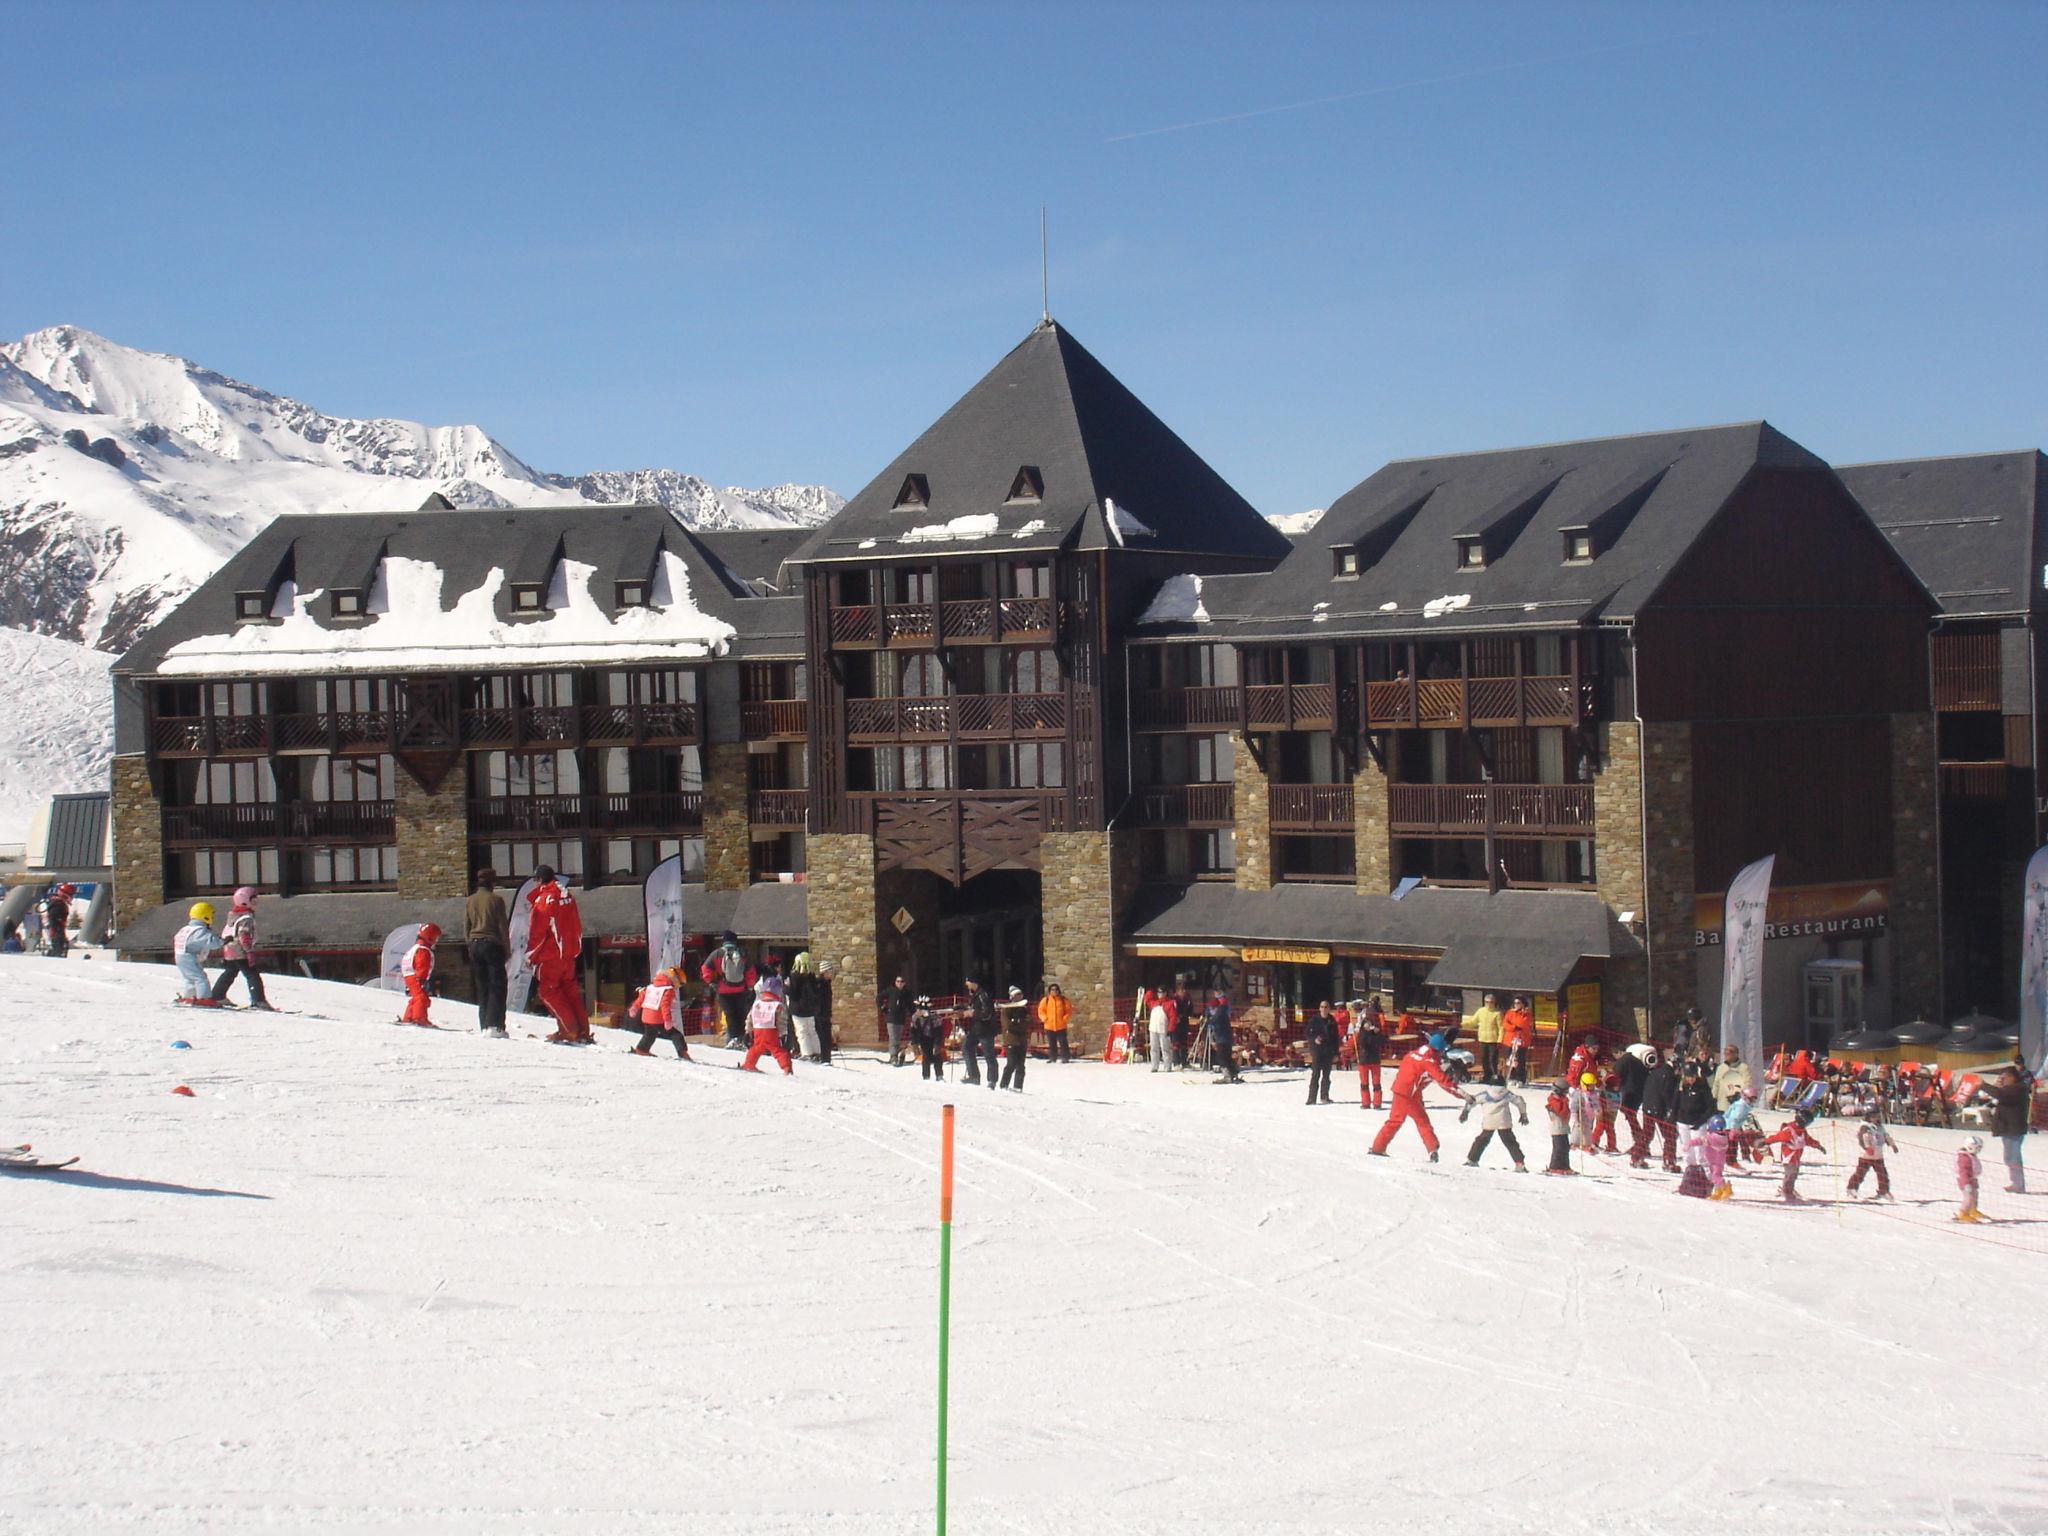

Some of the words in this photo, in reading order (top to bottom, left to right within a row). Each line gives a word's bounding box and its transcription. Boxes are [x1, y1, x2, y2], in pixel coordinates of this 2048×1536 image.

[611, 934, 637, 945] Les
[1695, 930, 1720, 946] Ba
[1764, 914, 1885, 939] Restaurant
